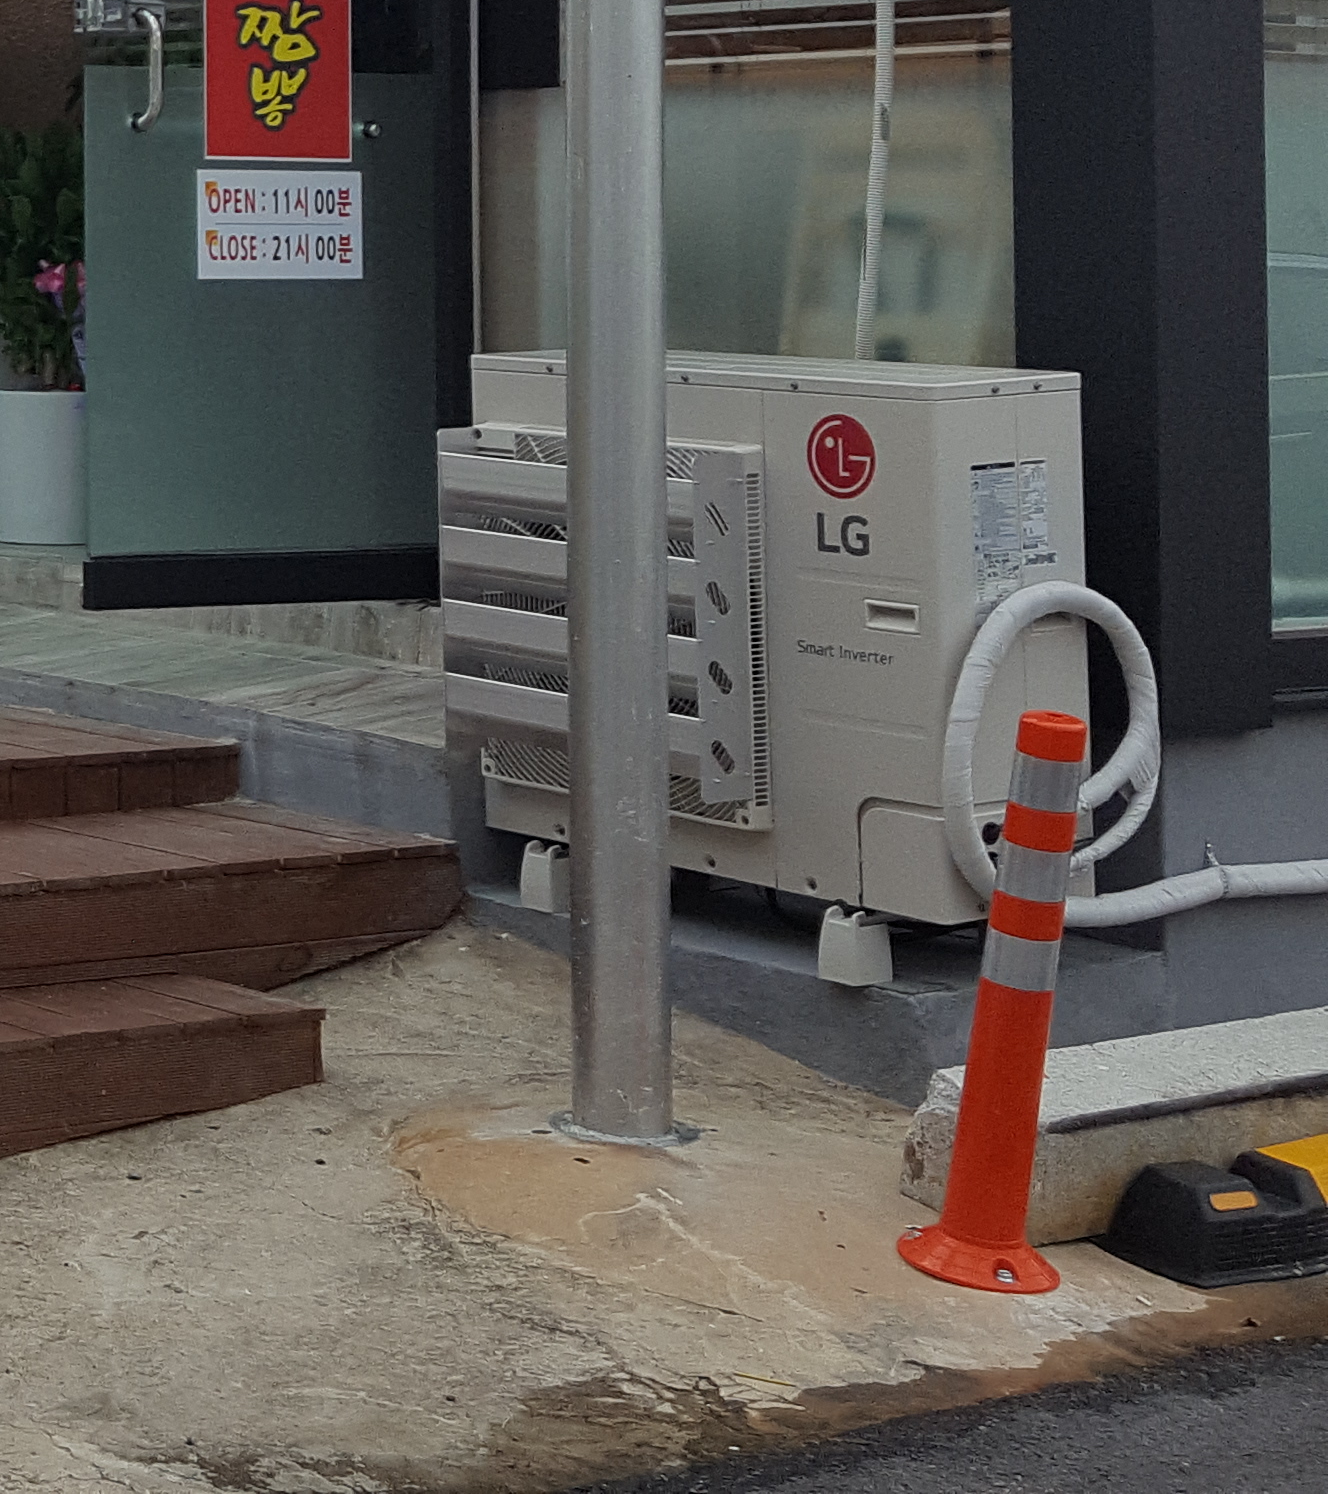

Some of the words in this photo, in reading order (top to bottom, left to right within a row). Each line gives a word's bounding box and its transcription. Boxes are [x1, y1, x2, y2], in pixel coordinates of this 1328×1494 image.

[817, 512, 870, 557] LG
[797, 639, 835, 658] Smart
[839, 645, 895, 666] Inverter
